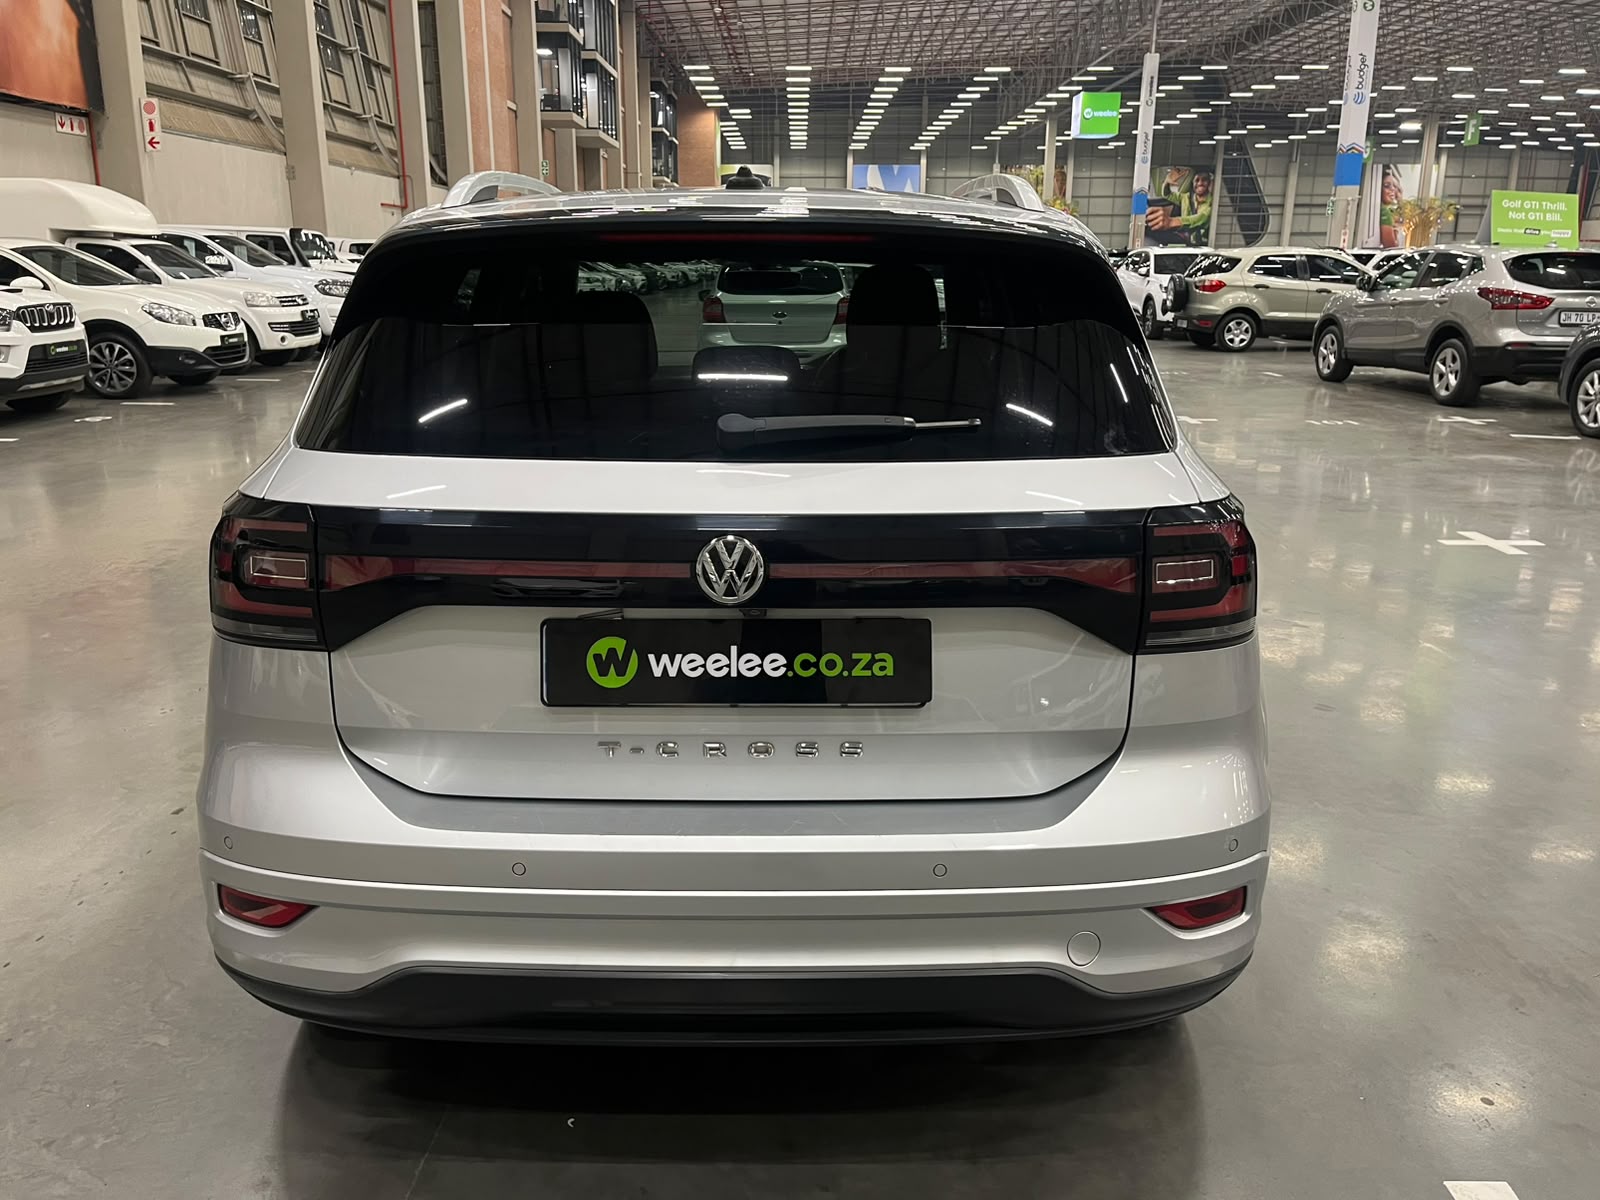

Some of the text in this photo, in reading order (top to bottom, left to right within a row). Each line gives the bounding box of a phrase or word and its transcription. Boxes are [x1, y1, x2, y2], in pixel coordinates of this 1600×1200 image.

[1356, 53, 1369, 90] budget
[1467, 119, 1478, 141] F
[1502, 199, 1568, 211] Golf GTI Thrill.
[1508, 211, 1563, 222] Not GTI Bill.
[1562, 313, 1597, 323] JH 70 LP
[647, 645, 895, 678] weelee.co.za
[597, 741, 864, 758] T-CROSS
